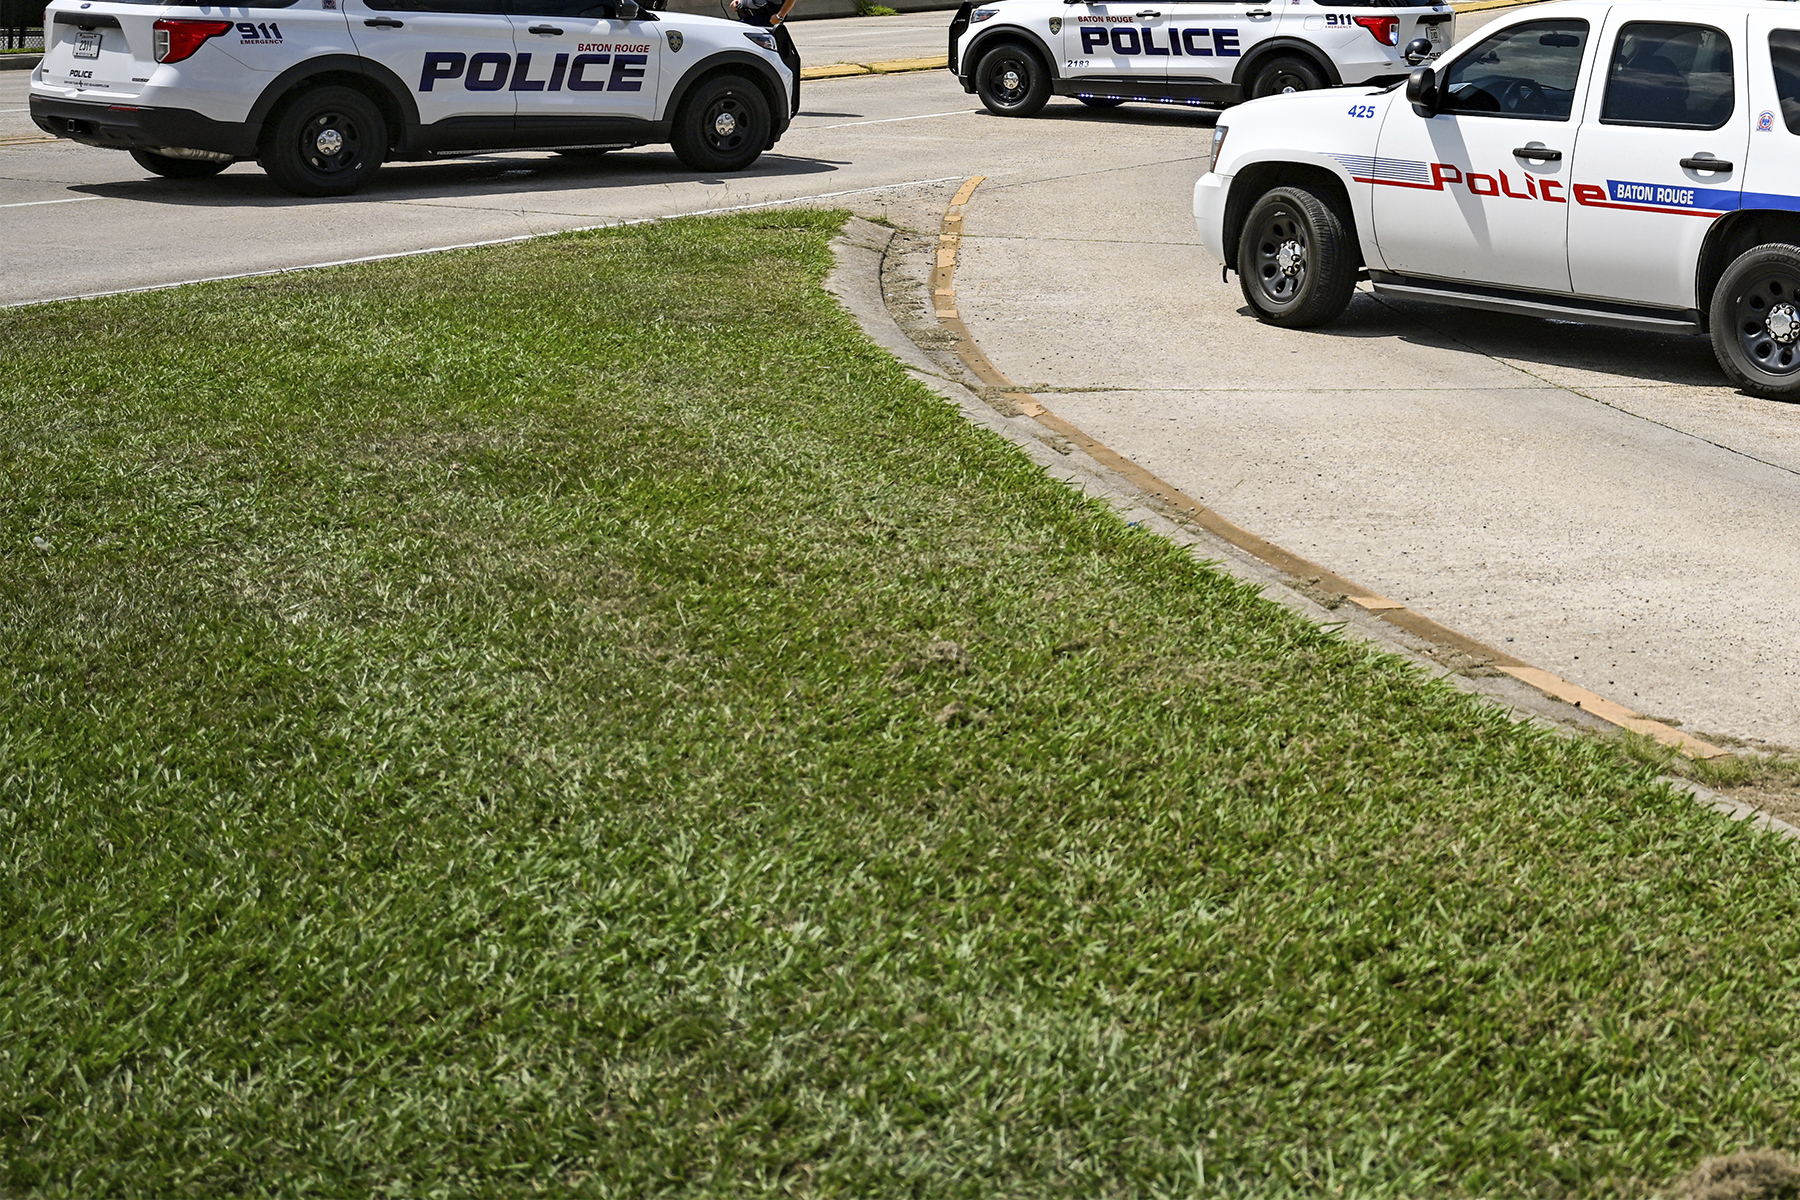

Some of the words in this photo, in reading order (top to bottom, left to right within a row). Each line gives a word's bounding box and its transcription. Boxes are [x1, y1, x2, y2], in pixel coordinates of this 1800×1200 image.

[1078, 15, 1104, 23] BATON
[1325, 14, 1352, 25] 911
[236, 22, 283, 39] 911
[577, 43, 612, 52] BATON
[614, 44, 650, 53] ROUGE
[1080, 27, 1241, 56] POLICE
[1067, 60, 1090, 68] 2183
[69, 69, 93, 78] POLICE
[418, 52, 648, 92] POLICE
[1347, 104, 1376, 119] 425
[1617, 184, 1653, 201] BATON
[1656, 187, 1694, 205] ROUGE
